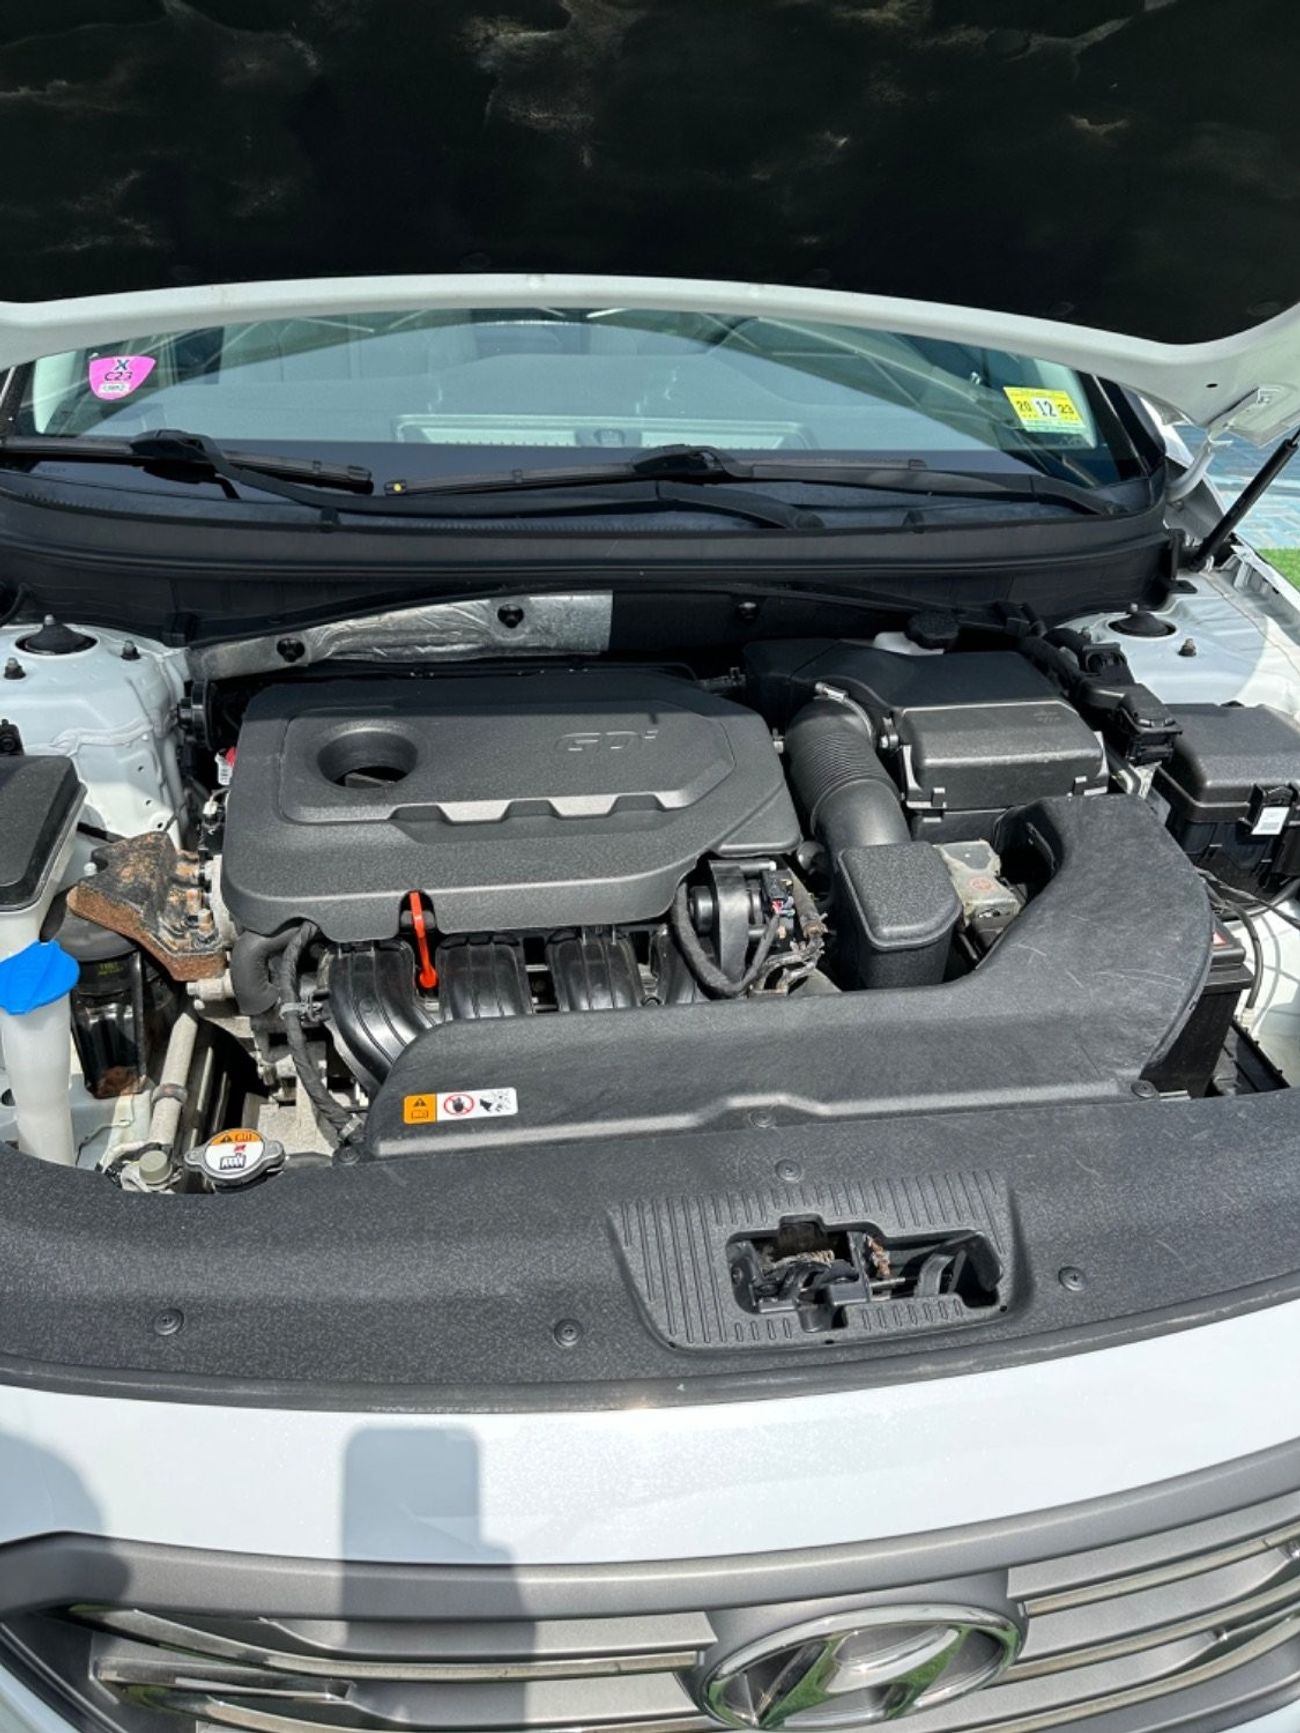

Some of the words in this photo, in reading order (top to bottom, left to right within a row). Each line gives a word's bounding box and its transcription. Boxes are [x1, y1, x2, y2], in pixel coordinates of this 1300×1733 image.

[104, 371, 133, 381] C23
[1016, 400, 1032, 412] 20
[1035, 400, 1057, 417] 12
[1057, 403, 1074, 414] 23
